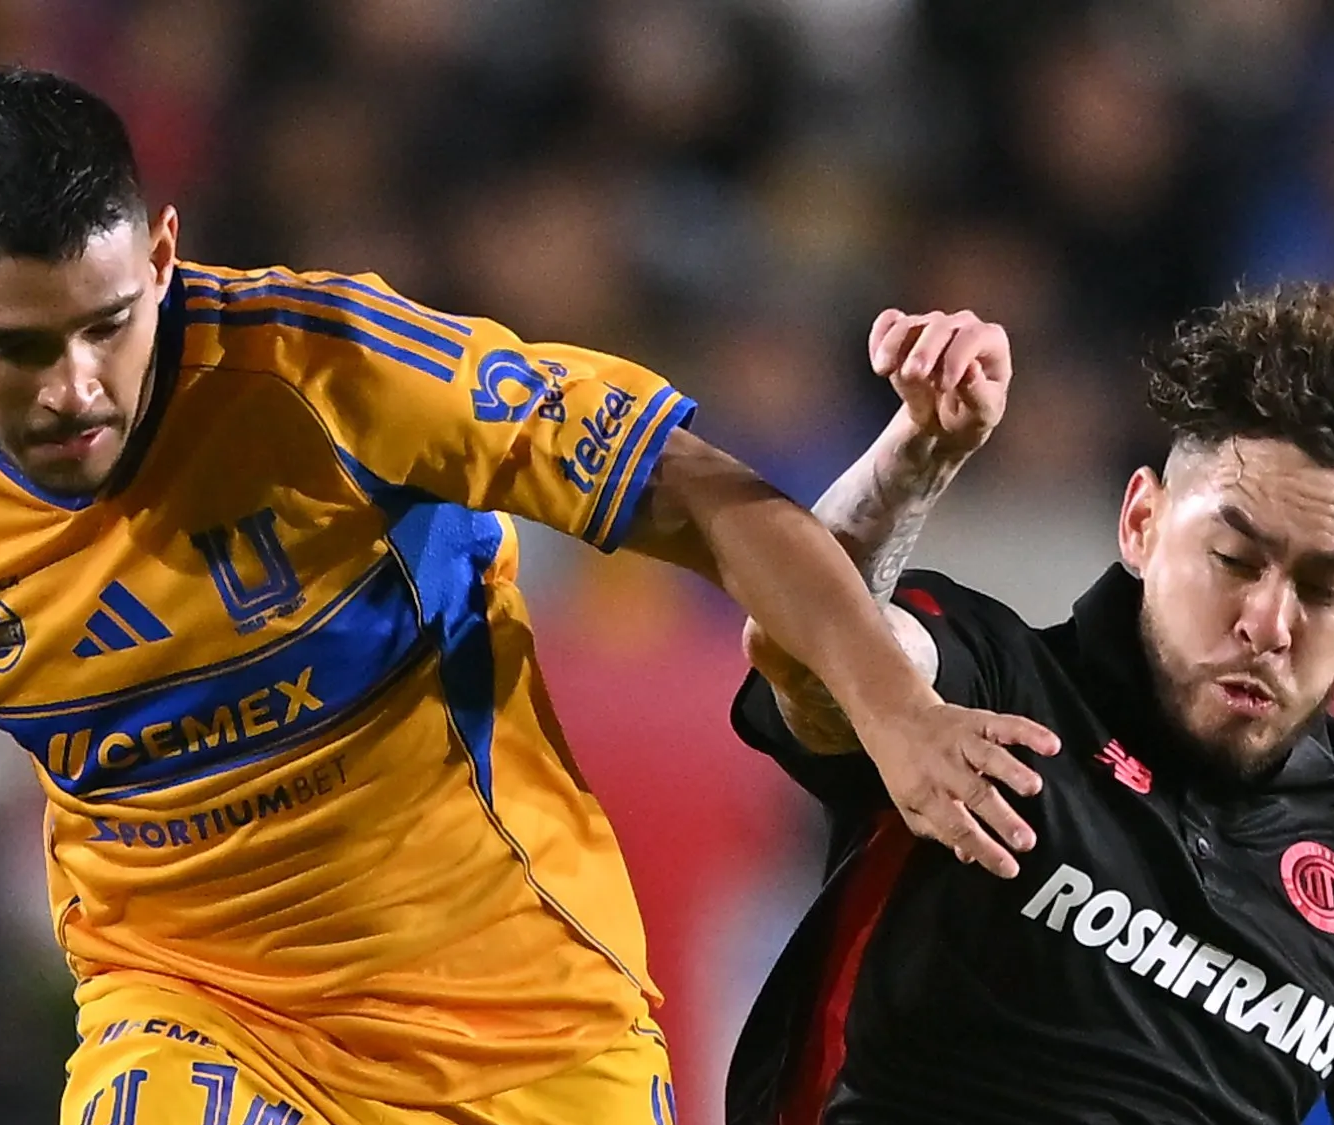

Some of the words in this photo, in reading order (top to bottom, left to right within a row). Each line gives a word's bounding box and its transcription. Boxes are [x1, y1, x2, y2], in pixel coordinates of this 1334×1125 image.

[557, 381, 637, 494] telcel
[97, 667, 324, 769] CEMEX
[86, 753, 348, 848] SPORTIUMBET
